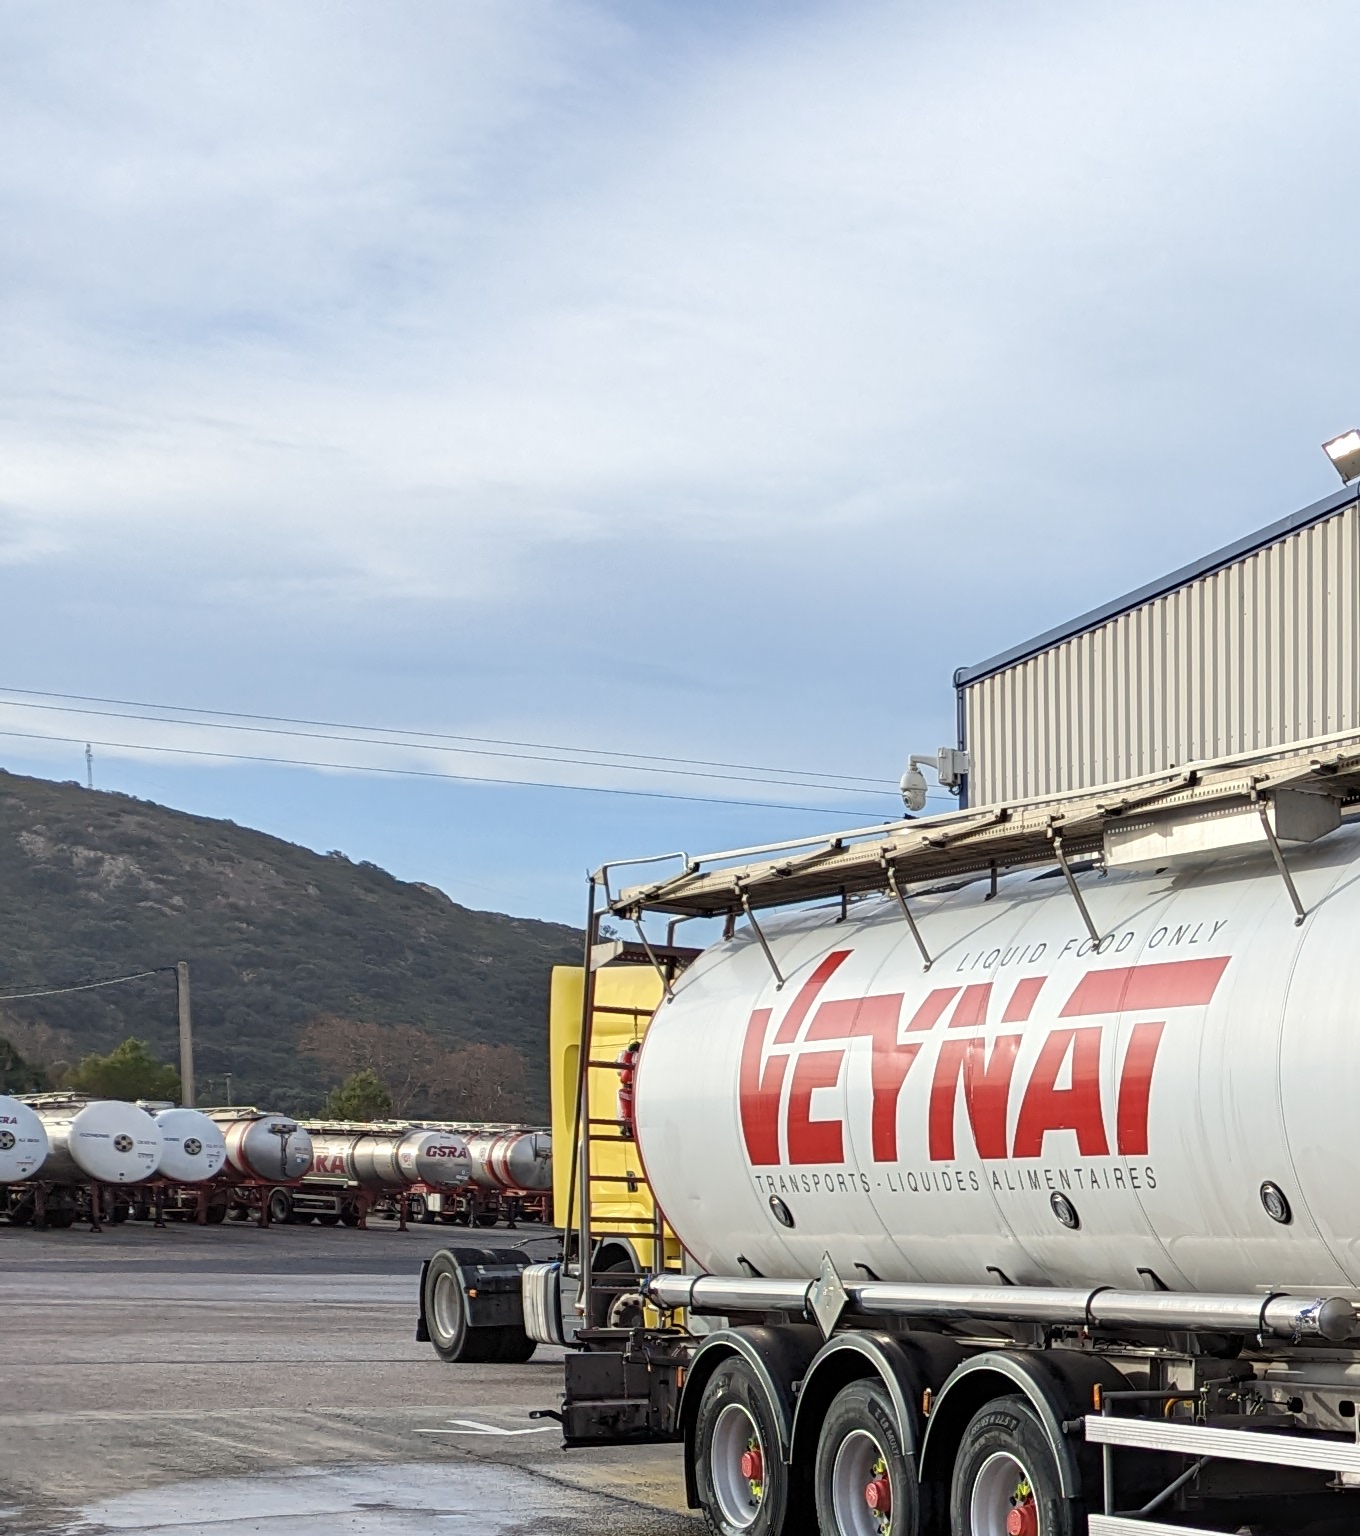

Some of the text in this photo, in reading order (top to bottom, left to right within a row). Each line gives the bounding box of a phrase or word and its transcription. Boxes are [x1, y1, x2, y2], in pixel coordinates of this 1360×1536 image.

[956, 919, 1229, 973] LIQUID FOOD ONLY
[738, 948, 1233, 1166] VEYNAT
[425, 1145, 468, 1159] GSRA
[755, 1171, 871, 1194] TRANSPORTS
[886, 1170, 980, 1193] LIQUIDES
[991, 1167, 1158, 1193] ALIMENTAIRES
